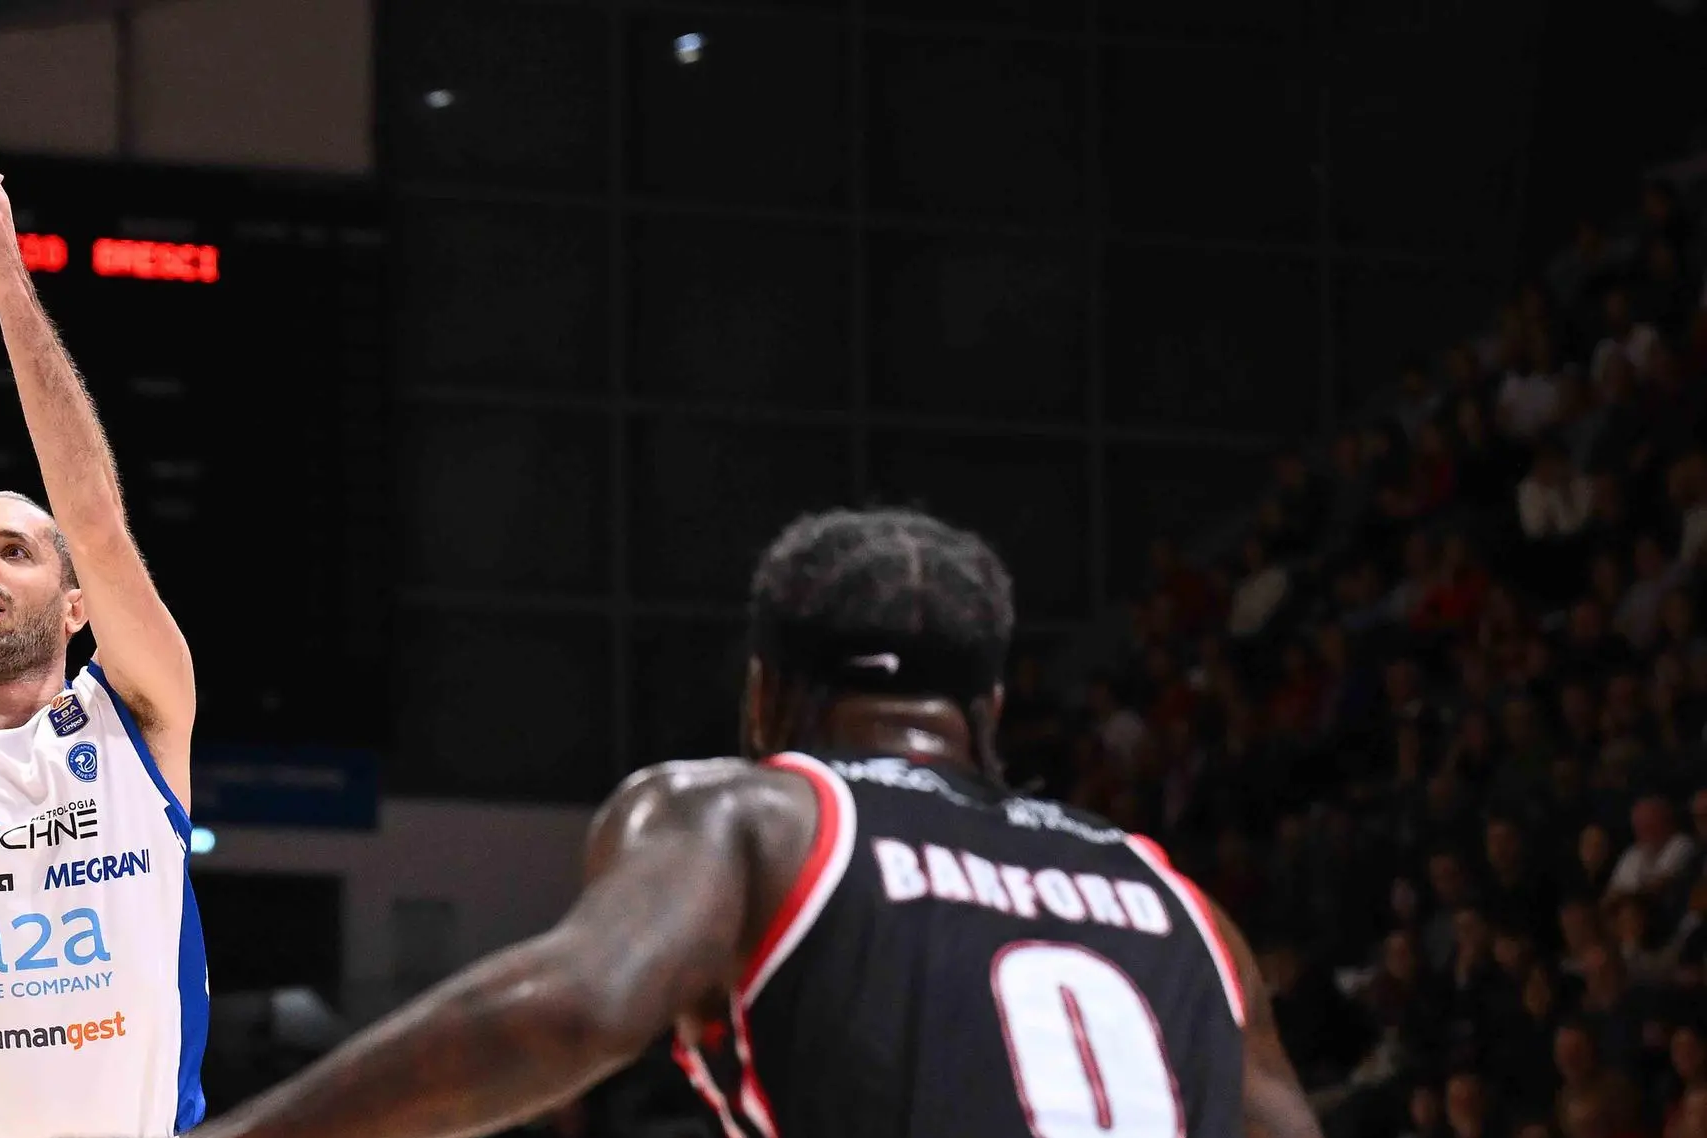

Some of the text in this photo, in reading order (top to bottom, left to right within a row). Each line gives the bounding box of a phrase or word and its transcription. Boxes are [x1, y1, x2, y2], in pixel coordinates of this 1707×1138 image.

[54, 705, 79, 723] LBA
[62, 717, 84, 732] Unipol
[872, 838, 1171, 937] BARFORD
[11, 971, 113, 998] COMPANY
